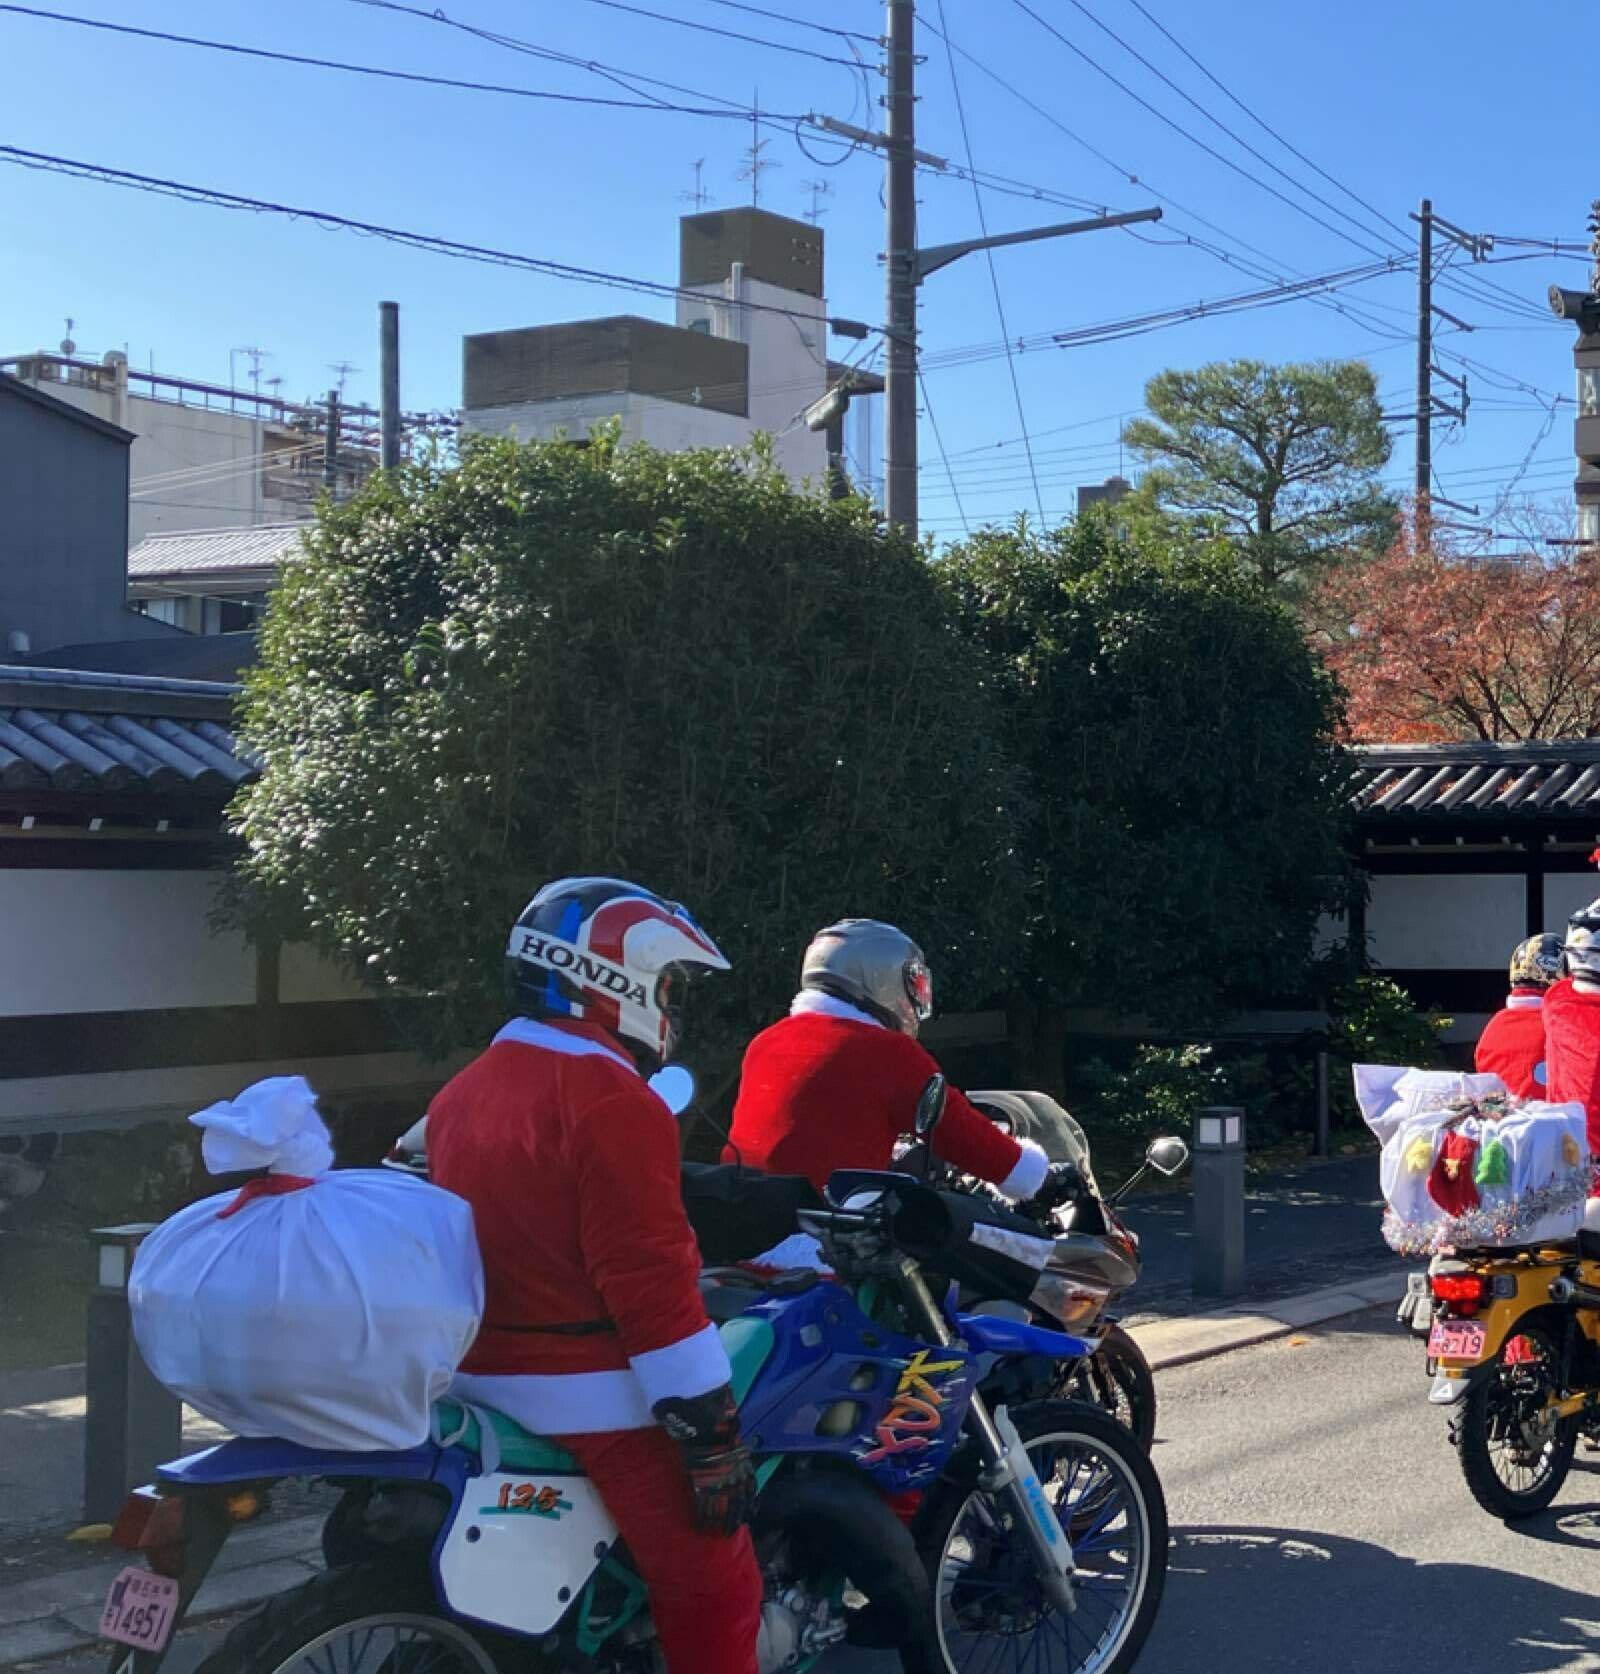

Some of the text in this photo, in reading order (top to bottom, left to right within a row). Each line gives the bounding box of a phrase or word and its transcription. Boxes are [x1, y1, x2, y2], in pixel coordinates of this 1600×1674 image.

[520, 934, 647, 1008] HONDA
[857, 1348, 964, 1467] KDX
[498, 1482, 562, 1513] 125
